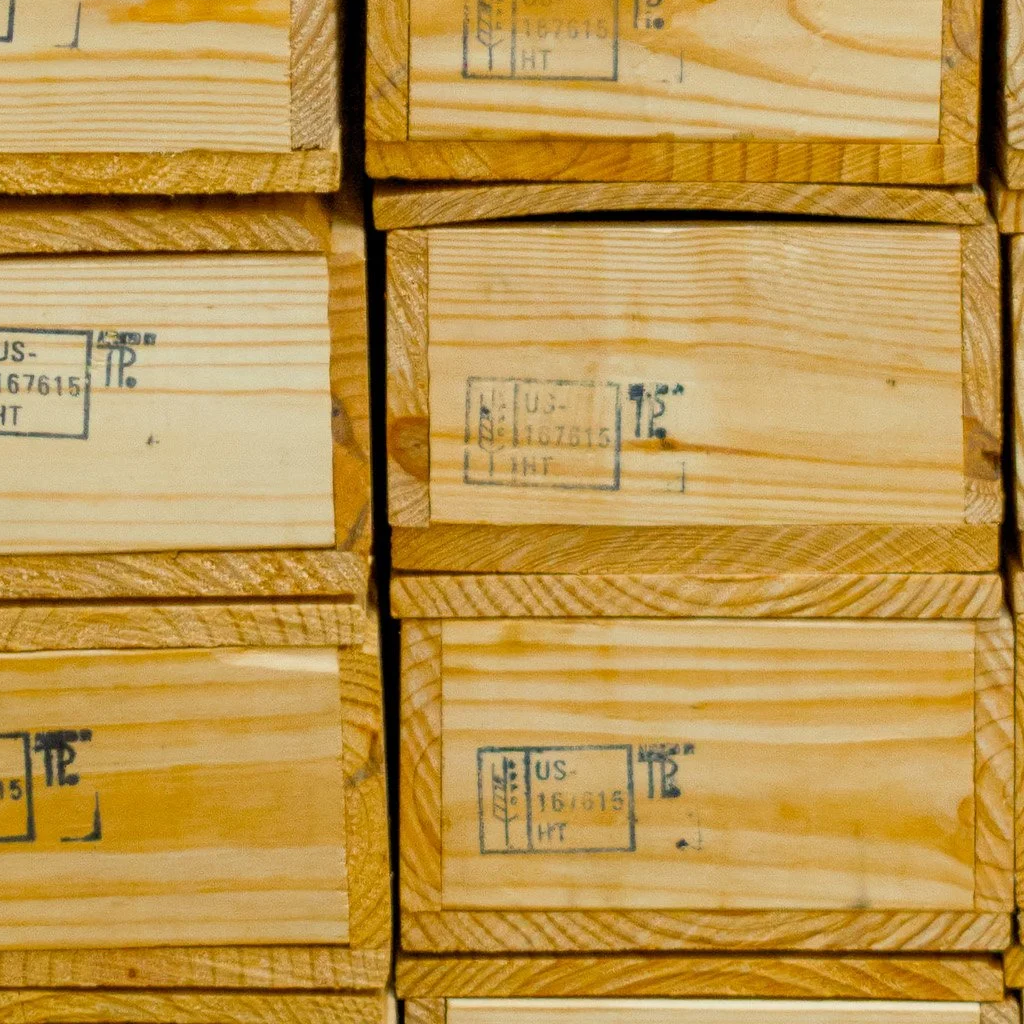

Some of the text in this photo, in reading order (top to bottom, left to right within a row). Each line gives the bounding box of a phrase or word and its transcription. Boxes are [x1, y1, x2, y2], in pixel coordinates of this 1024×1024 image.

[521, 50, 551, 70] HT
[535, 760, 576, 780] US-
[538, 822, 566, 842] HT
